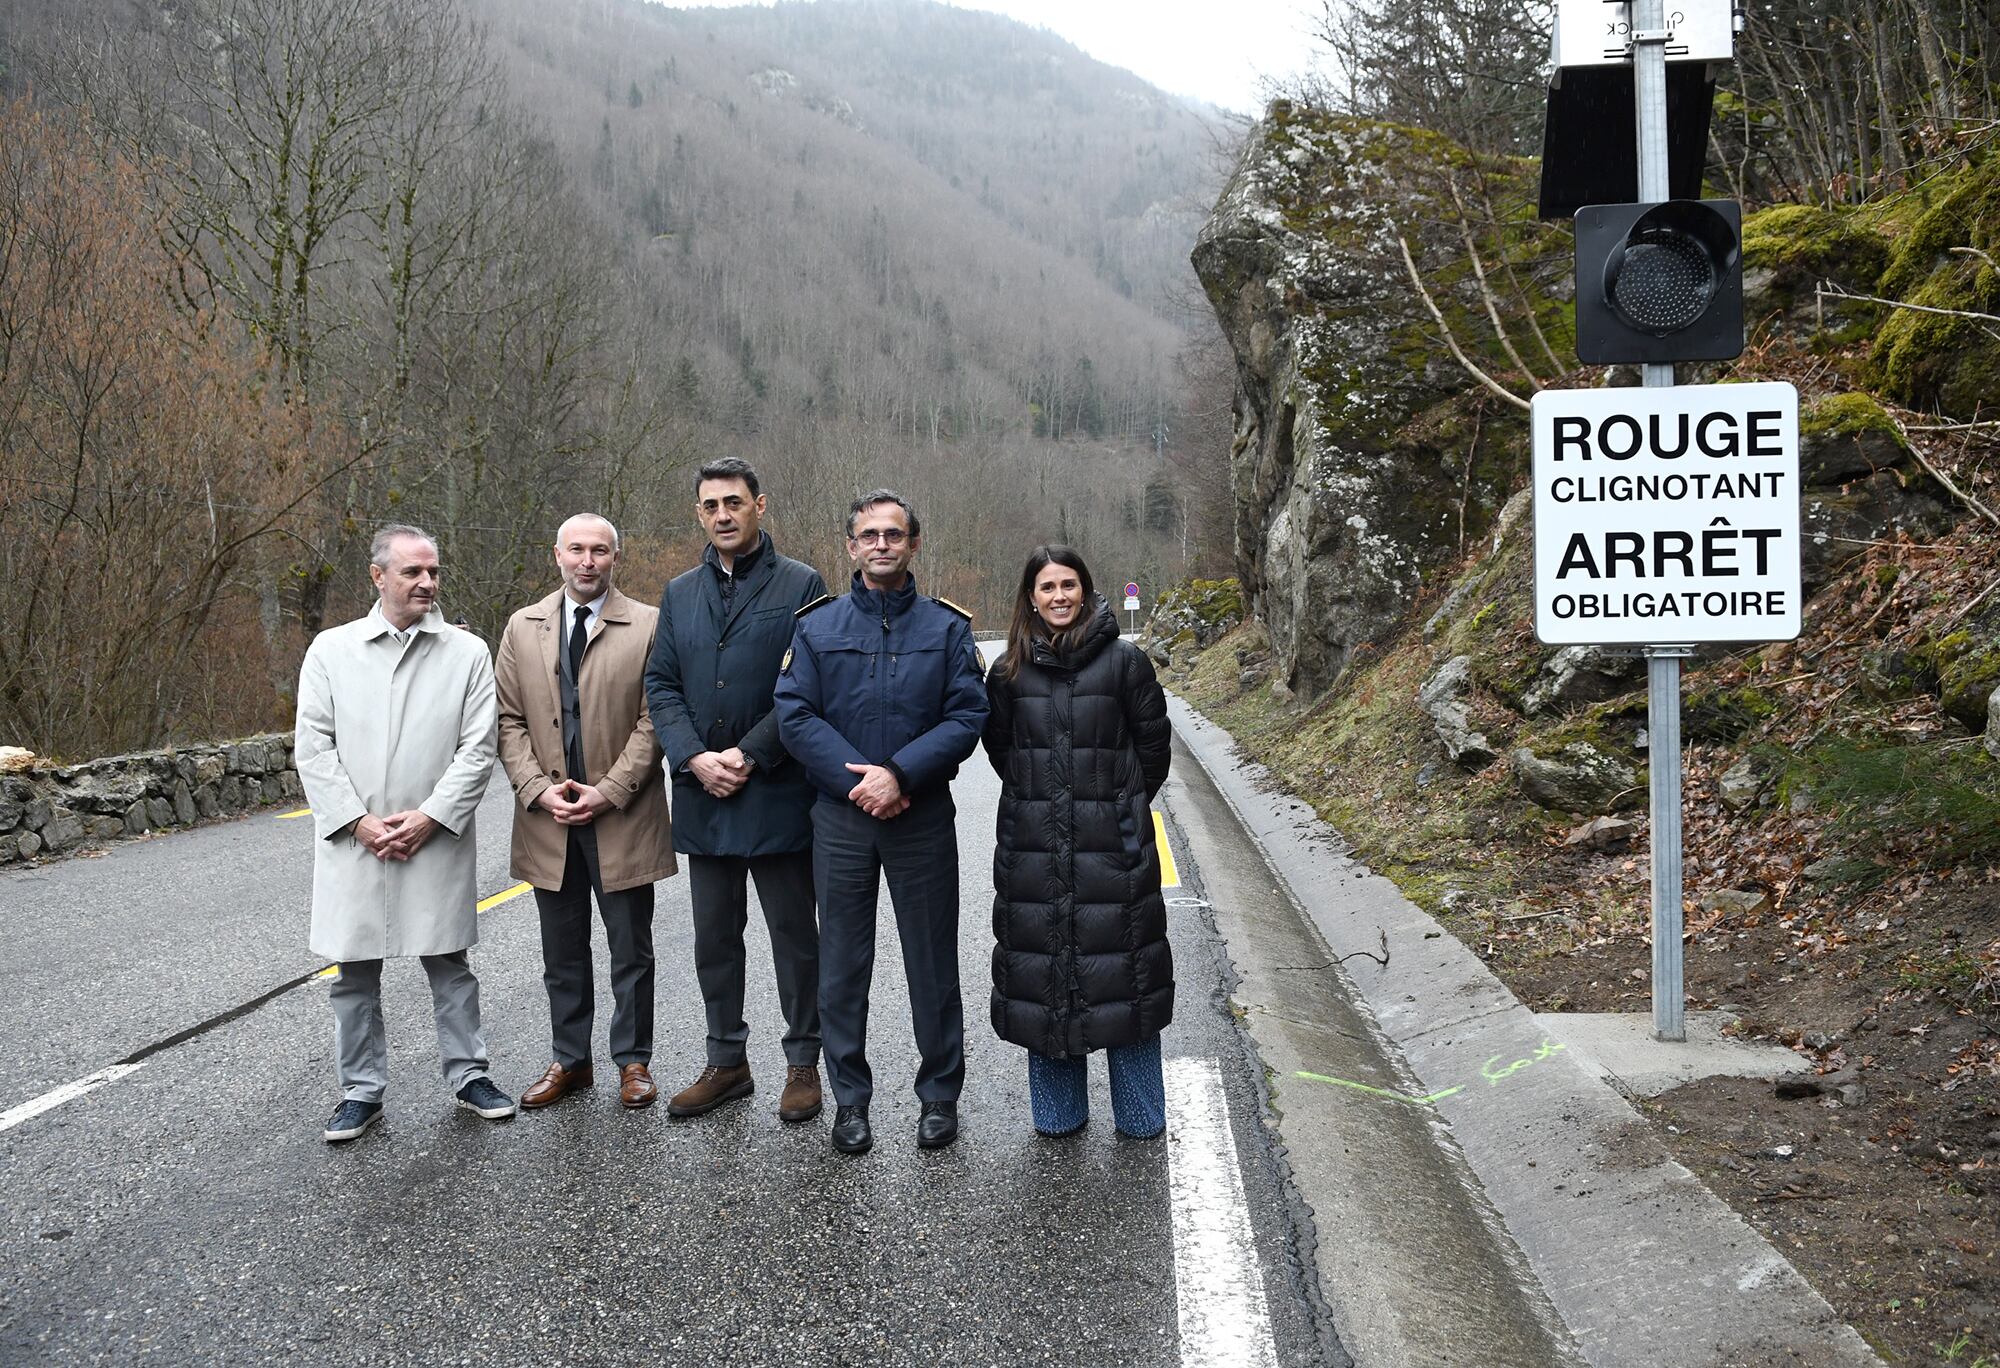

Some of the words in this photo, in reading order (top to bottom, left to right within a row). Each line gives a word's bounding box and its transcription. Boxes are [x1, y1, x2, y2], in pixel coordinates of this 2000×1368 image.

[1553, 410, 1783, 462] ROUGE
[1550, 472, 1785, 503] CLIGNOTANT
[1555, 516, 1782, 580] ARRÊT
[1551, 590, 1786, 619] OBLIGATOIRE
